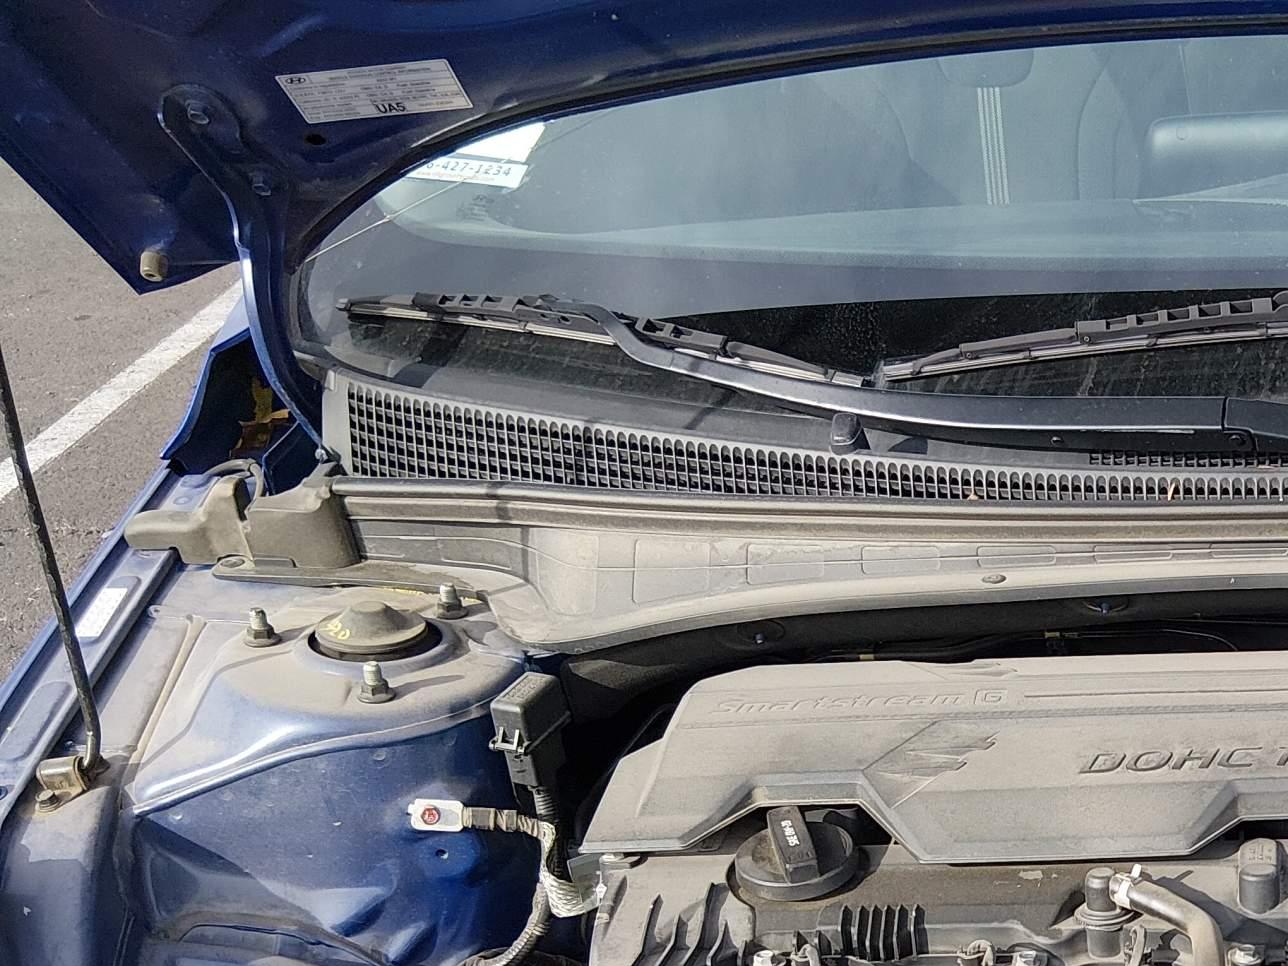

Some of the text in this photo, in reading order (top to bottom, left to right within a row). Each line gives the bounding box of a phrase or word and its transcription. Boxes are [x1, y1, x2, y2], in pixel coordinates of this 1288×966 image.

[375, 102, 406, 114] UA5
[709, 692, 966, 714] Smartstream
[1078, 746, 1263, 774] DOHC
